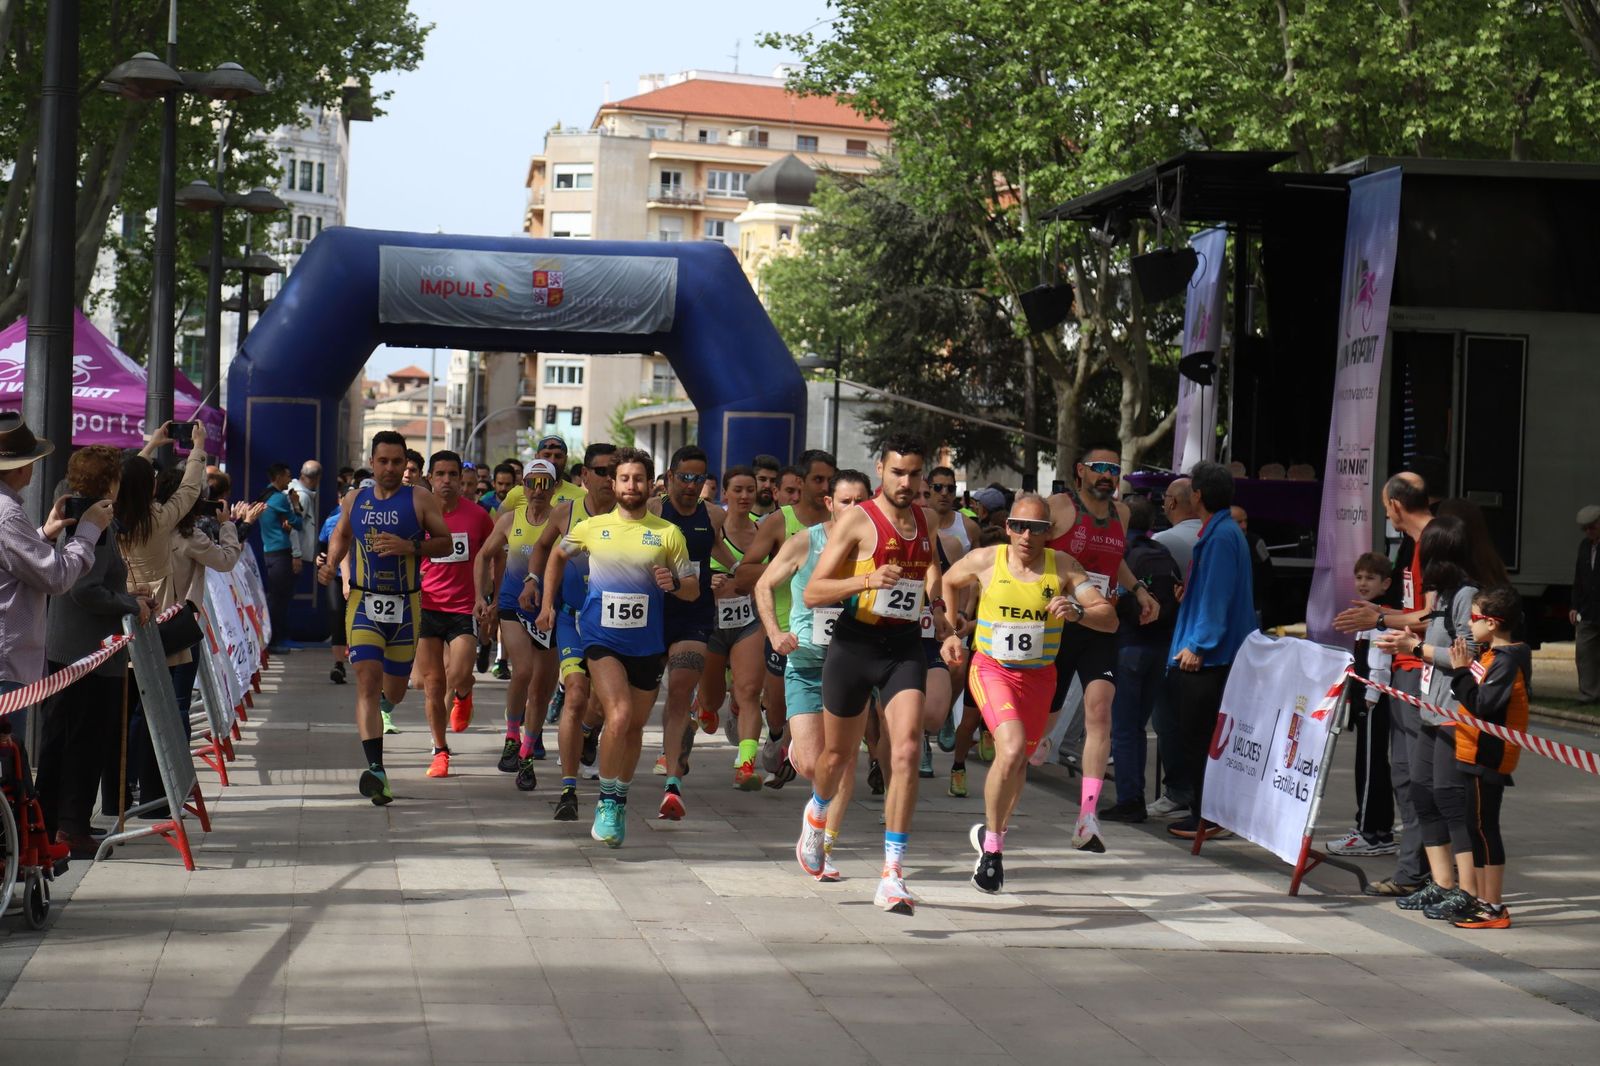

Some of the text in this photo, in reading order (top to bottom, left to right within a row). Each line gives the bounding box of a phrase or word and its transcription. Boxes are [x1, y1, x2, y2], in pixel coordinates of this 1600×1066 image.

[420, 264, 455, 278] NOS
[420, 279, 509, 300] IMPULSA
[361, 510, 399, 525] JESUS
[454, 541, 465, 555] 9
[373, 600, 395, 615] 92
[887, 590, 916, 611] 25
[606, 602, 644, 621] 156
[722, 604, 750, 622] 219
[999, 605, 1048, 622] TEAM
[1005, 633, 1032, 651] 18
